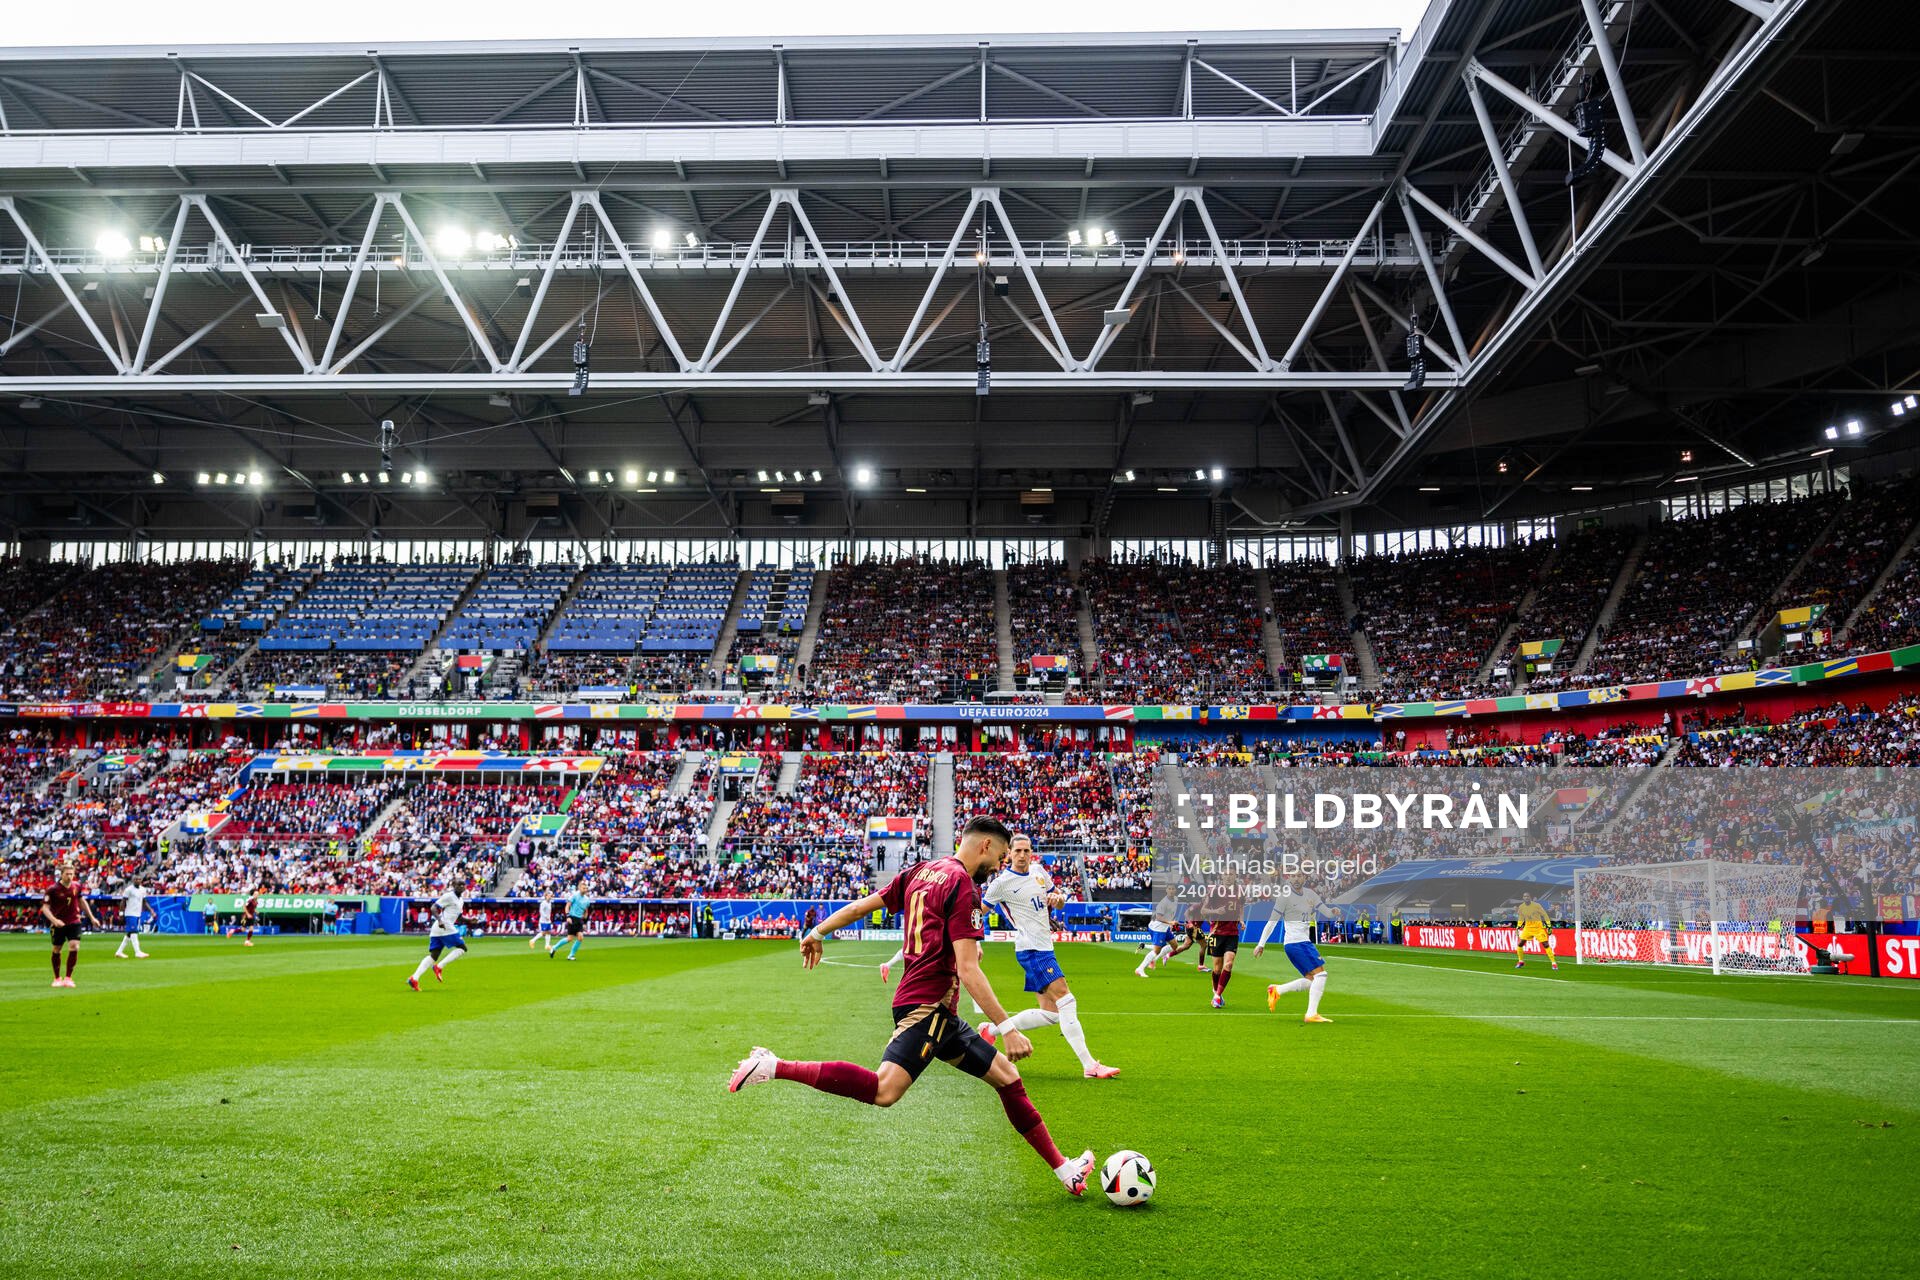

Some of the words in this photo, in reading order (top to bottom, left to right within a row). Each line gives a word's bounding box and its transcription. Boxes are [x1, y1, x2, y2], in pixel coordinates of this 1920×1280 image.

[399, 706, 482, 716] DÜSSELDORF
[66, 897, 72, 905] 7
[234, 898, 324, 909] DSSELDOR
[1030, 896, 1044, 911] 14
[1228, 901, 1237, 911] 21
[904, 890, 928, 954] 11
[834, 930, 859, 938] QATAR
[866, 930, 904, 940] Hisen
[1209, 937, 1217, 947] 21
[1419, 927, 1456, 946] STRAUSS
[1479, 929, 1541, 953] WORKWAR
[1575, 930, 1637, 958] TRAUSS
[1885, 938, 1920, 976] ST
